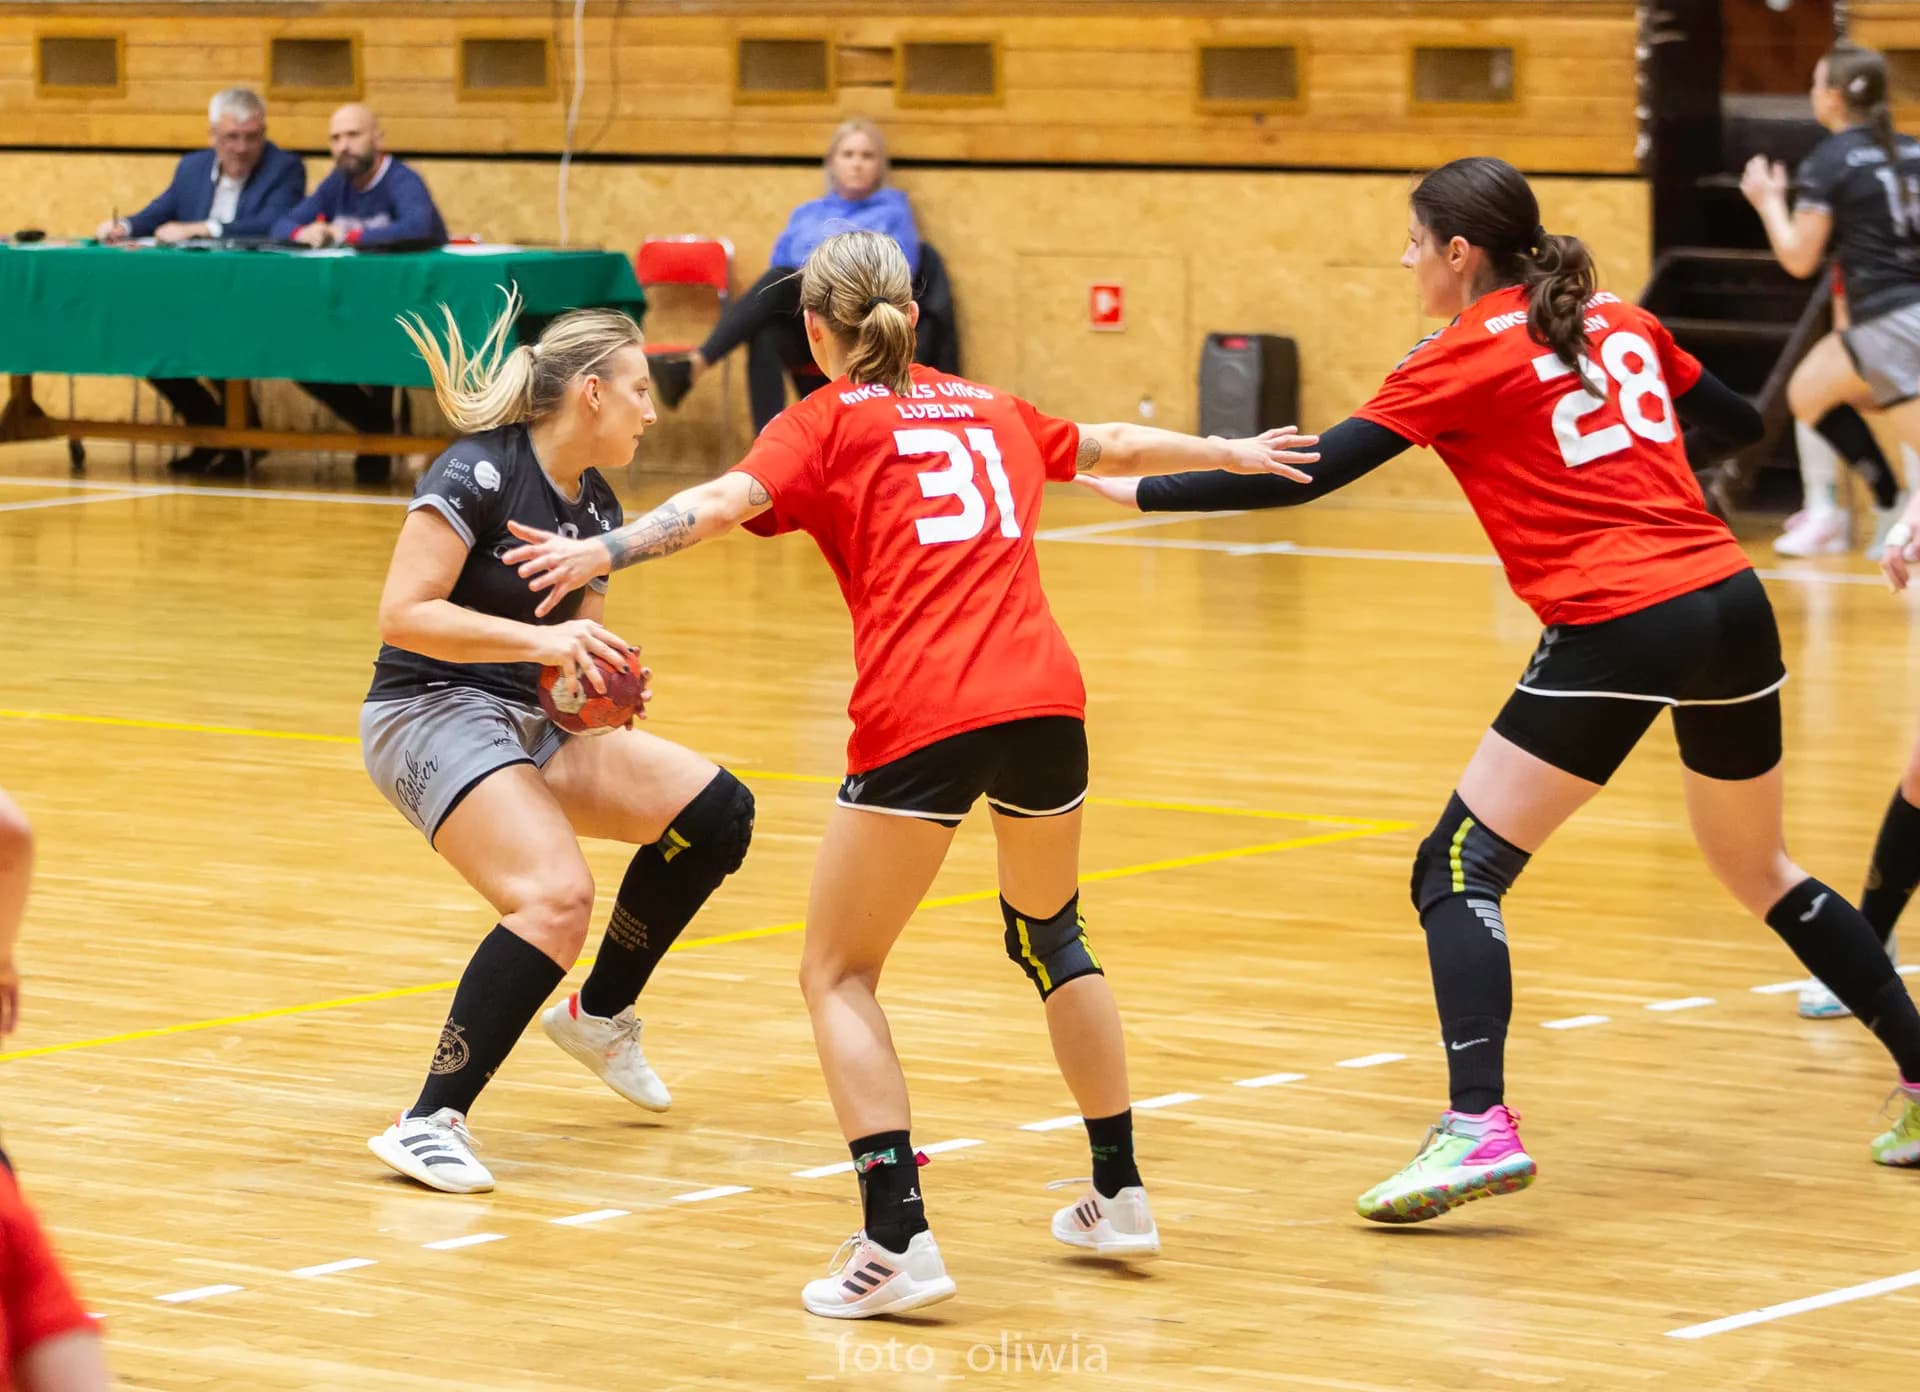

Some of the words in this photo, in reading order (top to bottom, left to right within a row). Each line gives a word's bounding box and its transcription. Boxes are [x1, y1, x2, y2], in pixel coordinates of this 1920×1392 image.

[1484, 310, 1529, 334] MKS
[839, 384, 890, 405] MKS
[903, 384, 936, 399] ZS
[1531, 331, 1676, 468] 28
[895, 403, 975, 419] LUBLIN
[448, 458, 470, 472] Sun
[893, 427, 1021, 545] 31
